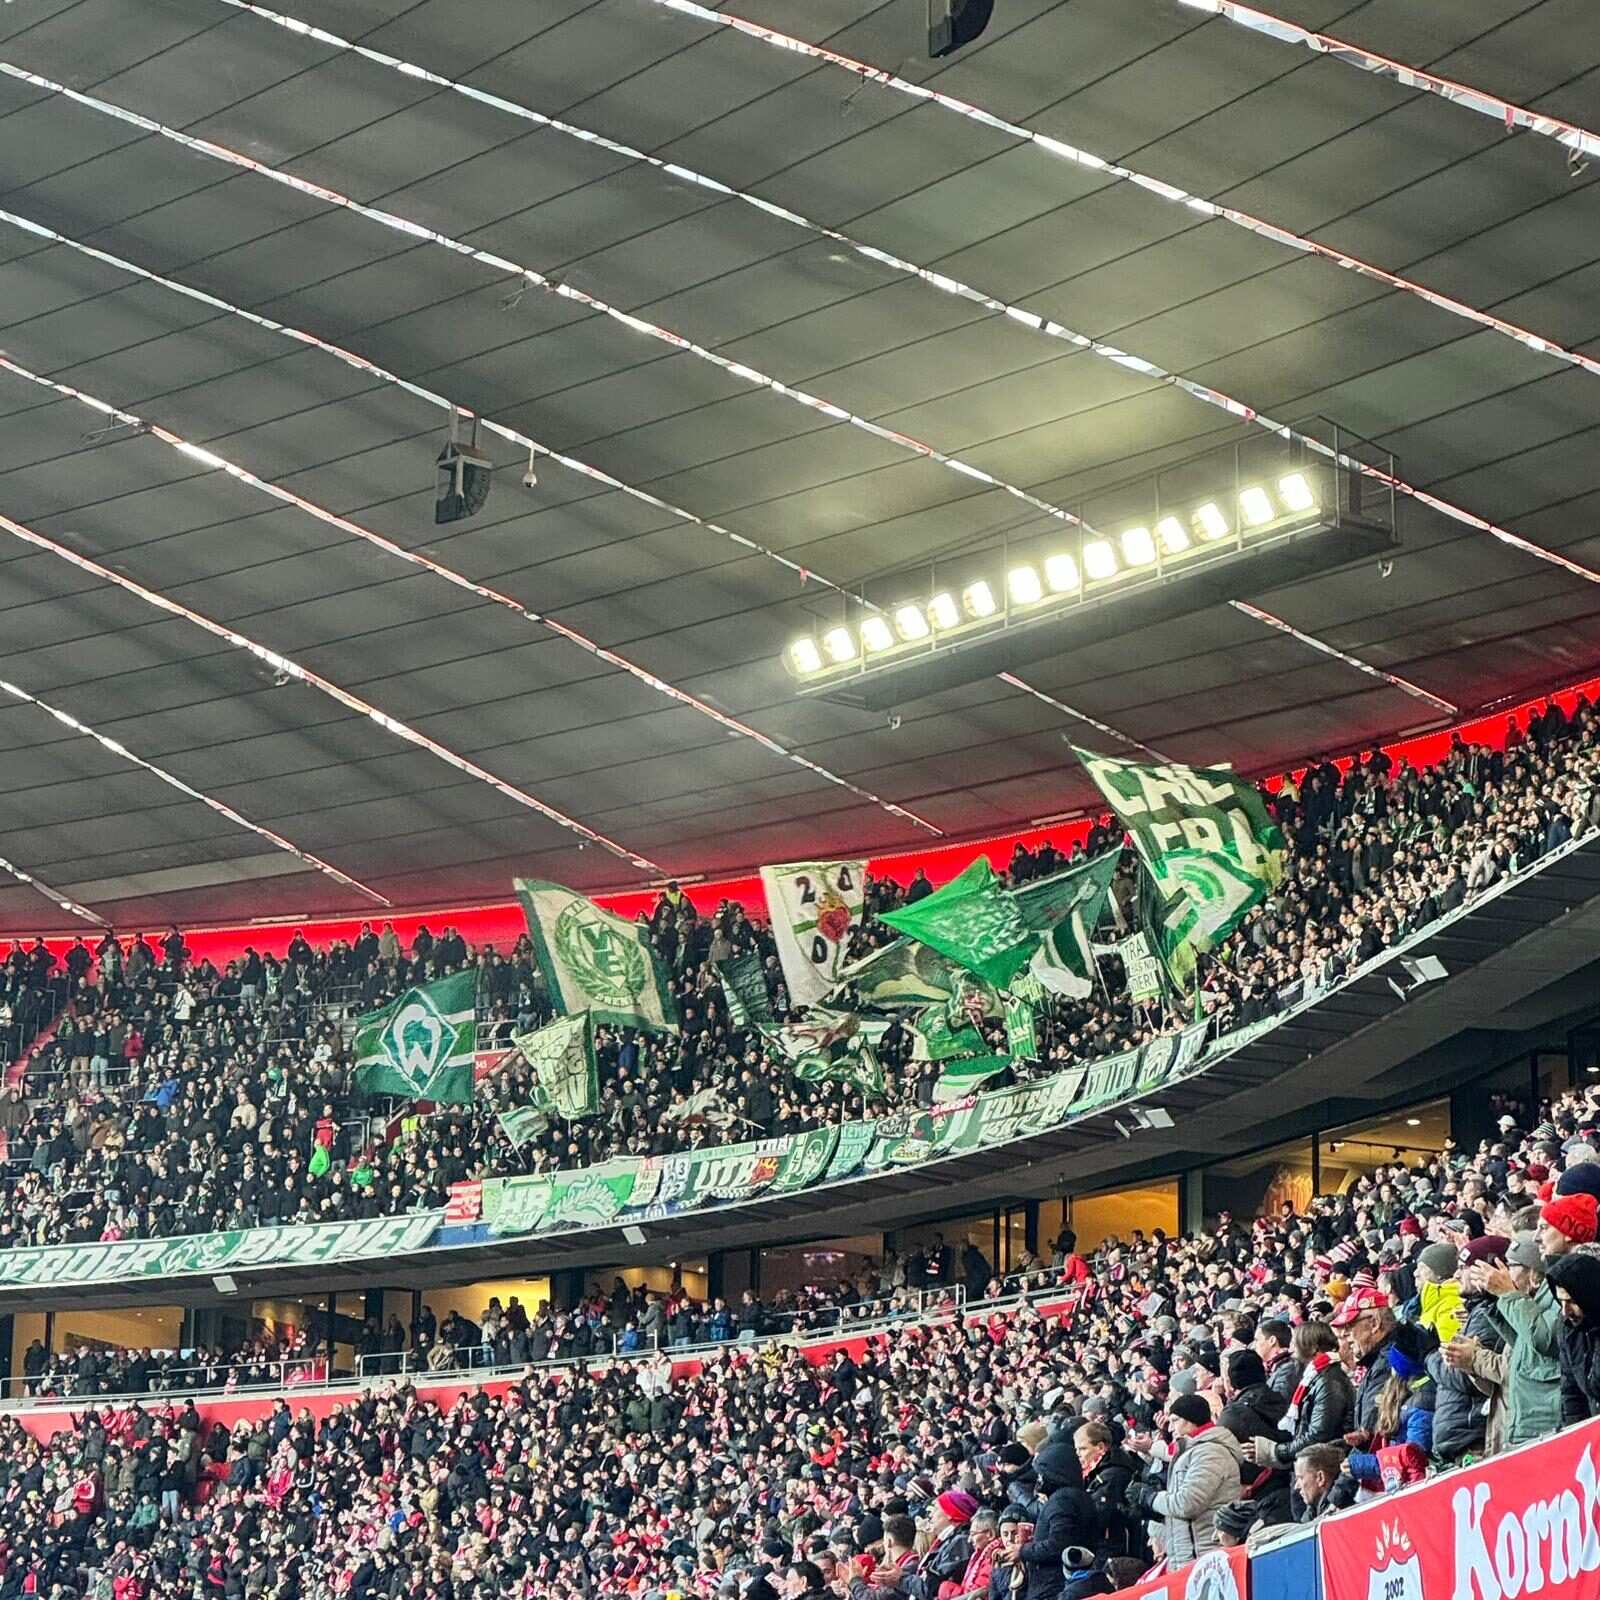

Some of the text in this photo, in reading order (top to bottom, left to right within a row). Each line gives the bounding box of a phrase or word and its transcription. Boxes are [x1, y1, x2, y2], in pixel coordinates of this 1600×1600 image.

[795, 876, 816, 905] 2
[0, 1242, 169, 1283] ERDER
[236, 1215, 444, 1264] BREMEN
